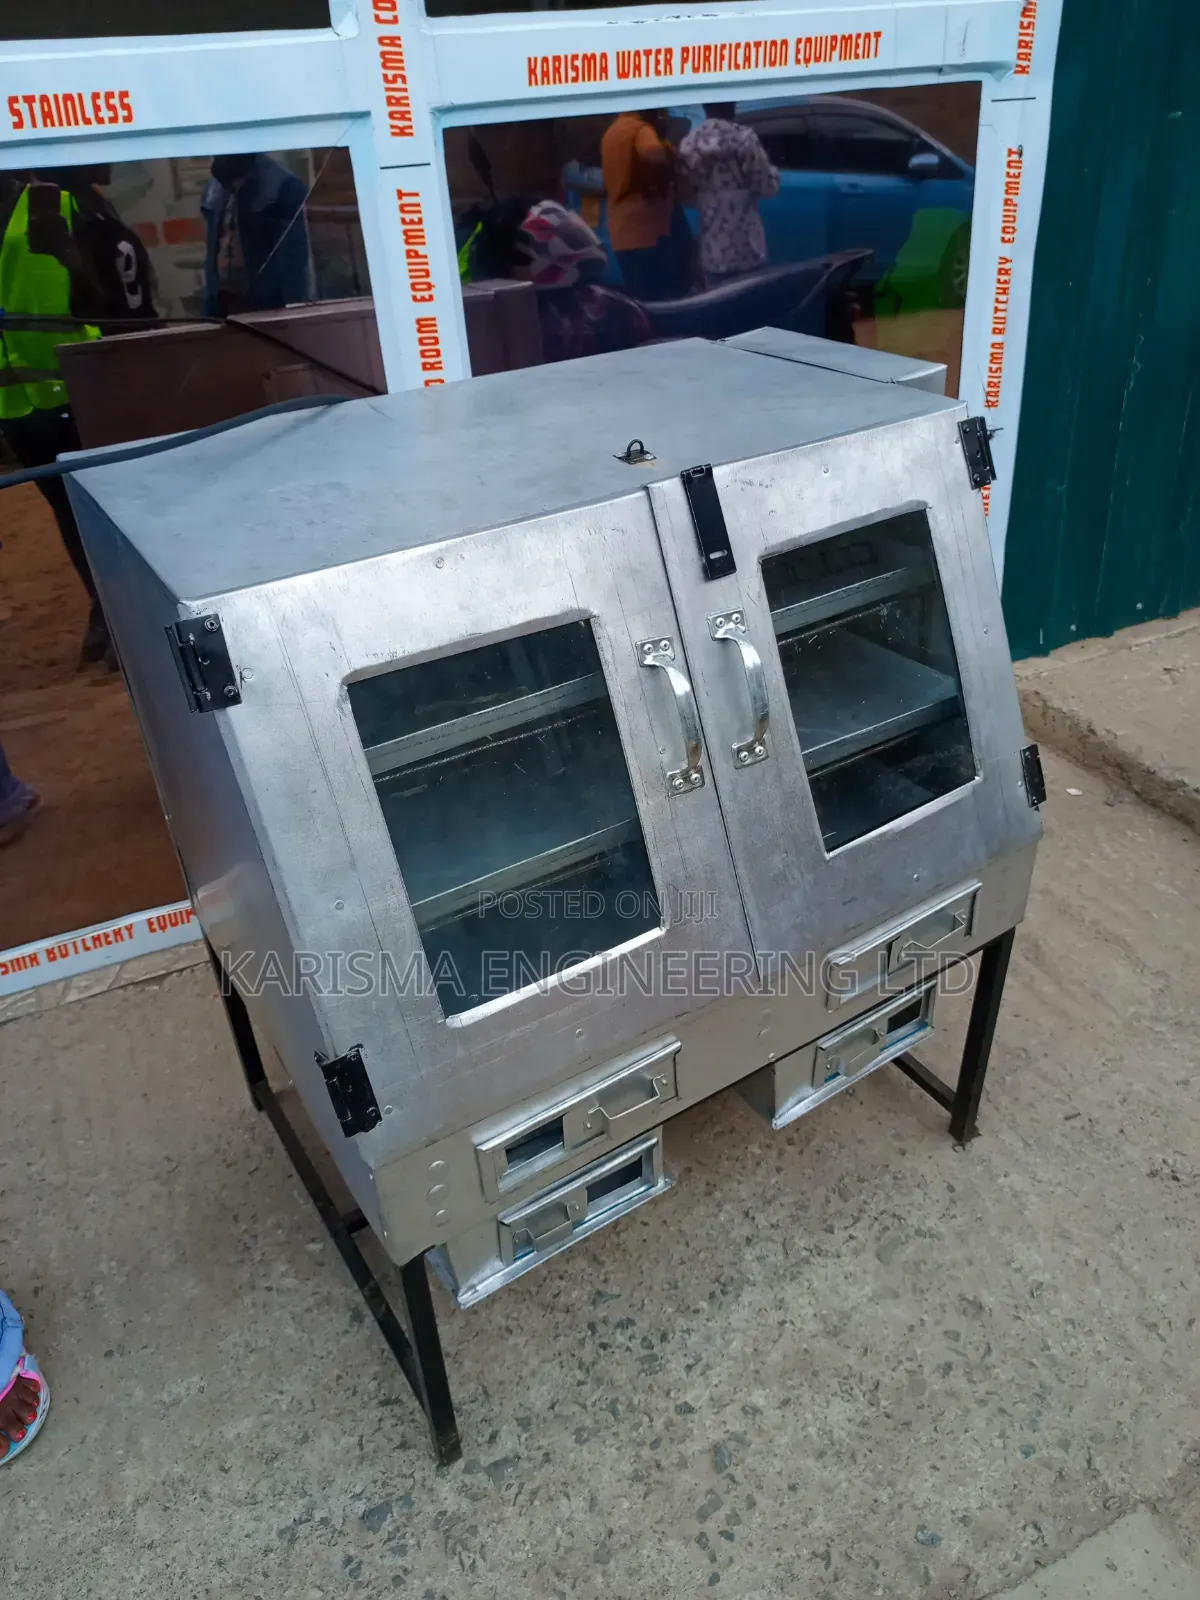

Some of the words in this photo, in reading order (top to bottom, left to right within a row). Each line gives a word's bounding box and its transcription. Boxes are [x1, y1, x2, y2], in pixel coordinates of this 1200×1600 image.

[377, 35, 415, 138] KARISMA
[527, 51, 610, 87] KARISMA
[616, 47, 675, 80] WATER
[680, 38, 790, 75] PURIFICATION
[794, 30, 883, 68] EQUIPMENT
[7, 90, 135, 130] STAINLESS
[1000, 147, 1023, 245] EQUIPMENT
[396, 188, 436, 303] EQUIPMENT
[991, 256, 1013, 336] BUTCHERY
[415, 316, 444, 372] ROOM
[984, 341, 1005, 409] KARISMA
[46, 923, 135, 963] BUTCHERY
